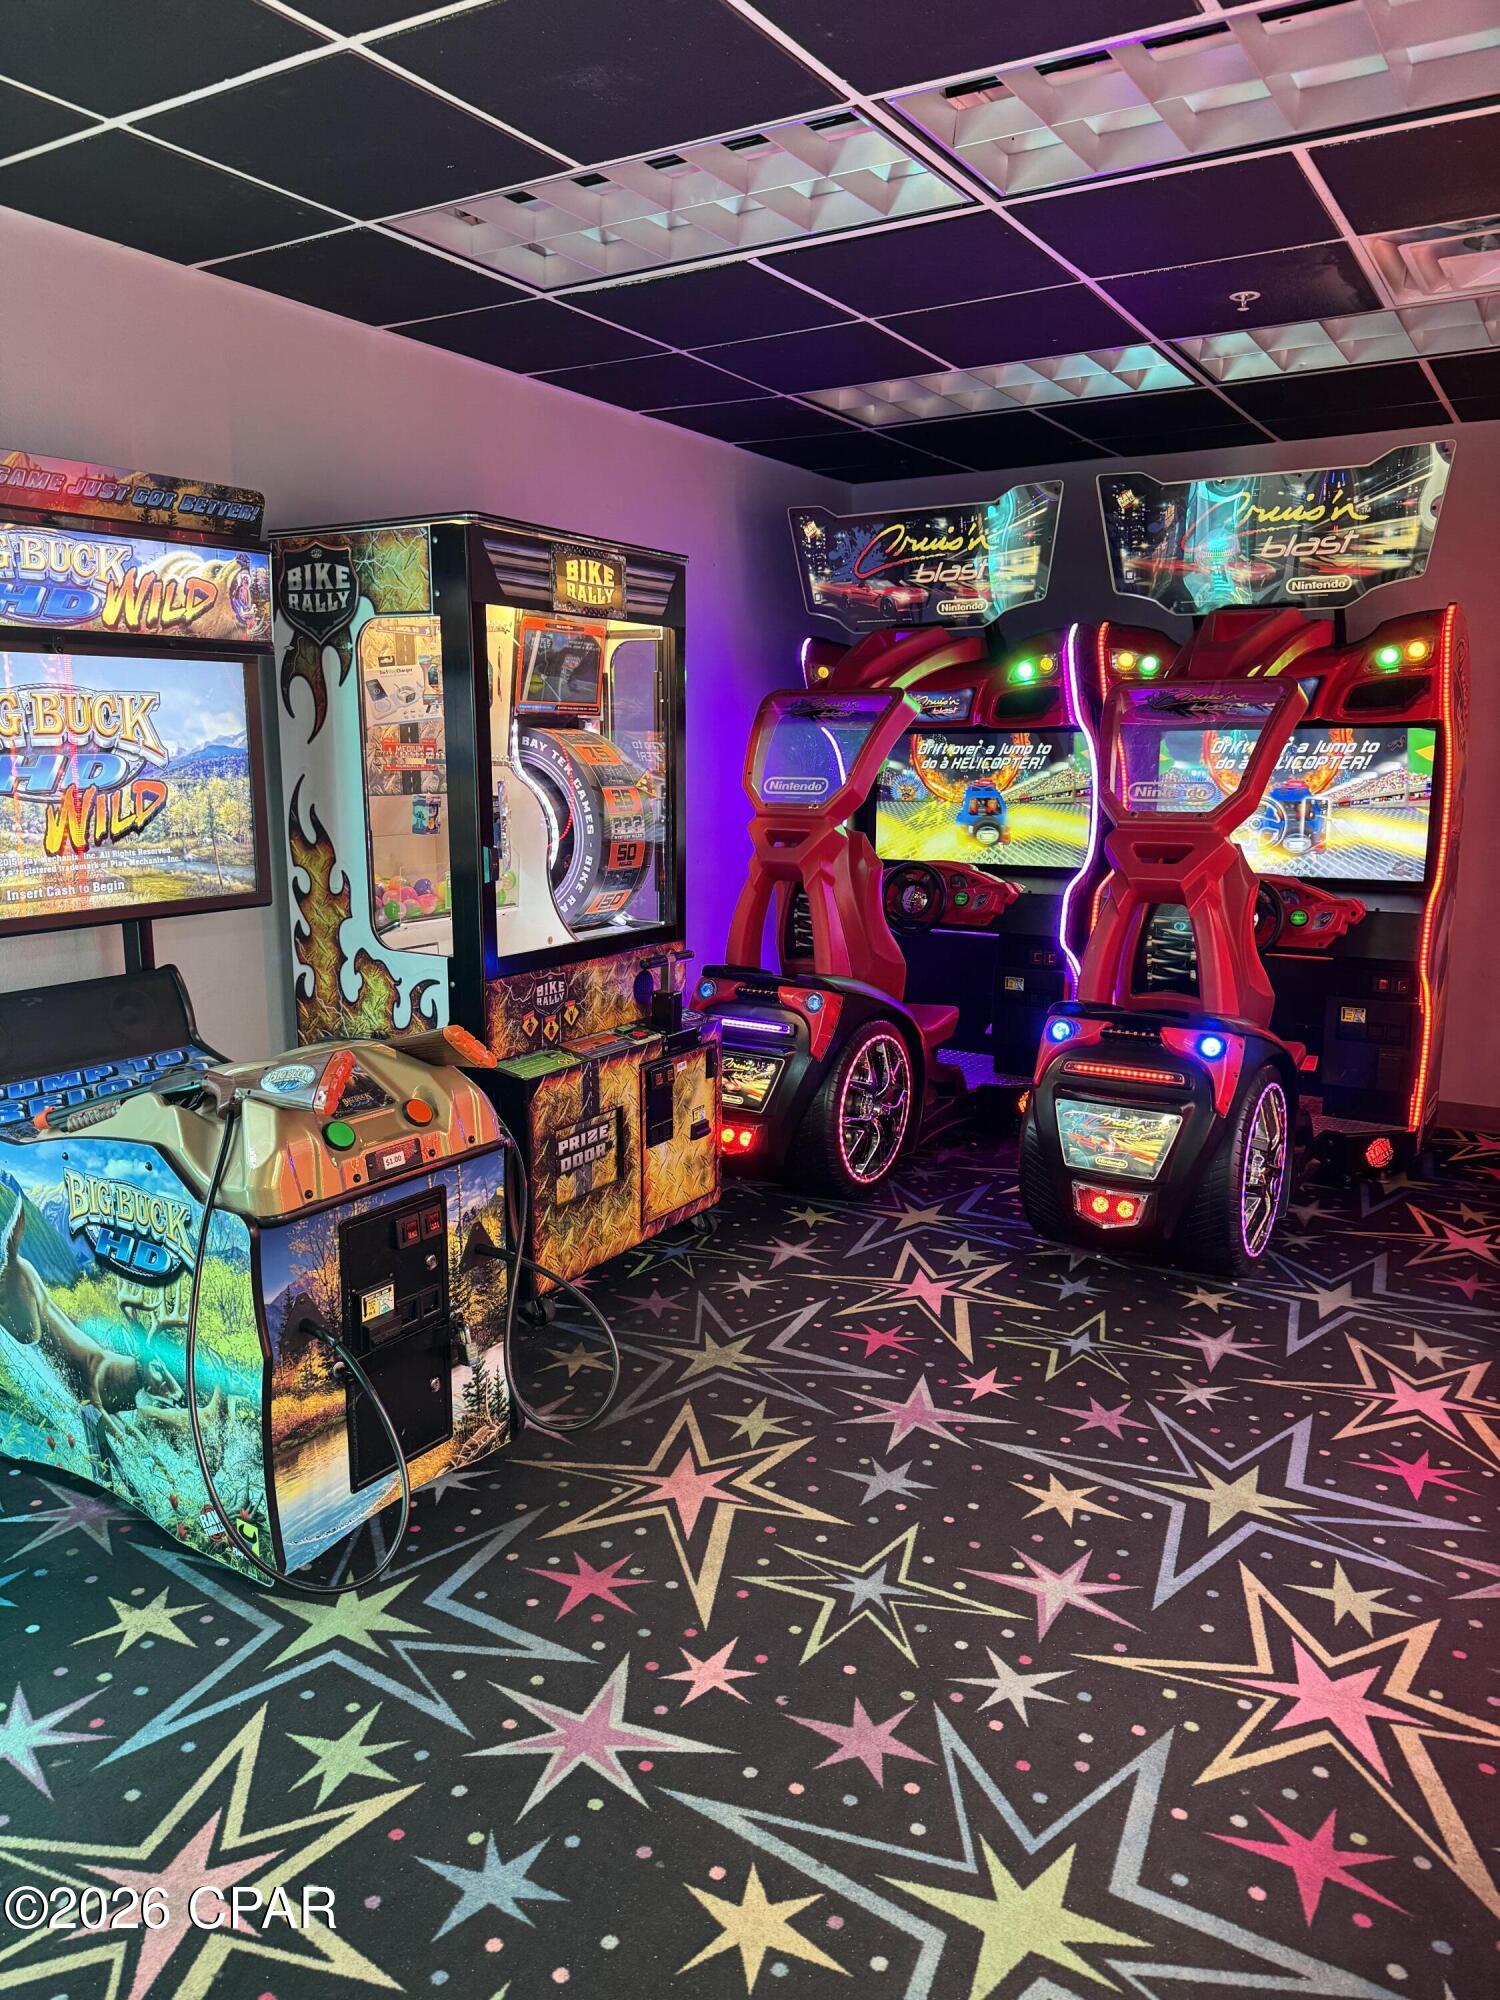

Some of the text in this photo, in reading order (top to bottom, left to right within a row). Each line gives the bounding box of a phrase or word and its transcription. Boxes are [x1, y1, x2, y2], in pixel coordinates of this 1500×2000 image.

[0, 466, 260, 522] GAME JUST GOT BETTER!
[1180, 488, 1370, 552] Cruis'n
[853, 523, 996, 580] Cruis'n
[1261, 529, 1359, 559] blast
[19, 535, 133, 586] BUCK
[565, 559, 615, 588] BIKE
[912, 558, 990, 584] blast
[287, 562, 351, 591] BIKE
[1290, 579, 1348, 591] Nintendo
[0, 566, 218, 632] HD WILD
[287, 590, 351, 613] RALLY
[566, 581, 615, 605] RALLY
[940, 602, 985, 613] Nintendo
[29, 691, 168, 761] BUCK
[521, 735, 548, 753] BAY
[918, 743, 950, 755] Drift
[951, 744, 981, 755] over
[985, 745, 996, 755] a
[1036, 743, 1052, 755] to
[1296, 743, 1307, 754] a
[1360, 740, 1381, 754] to
[0, 753, 130, 791] HD
[921, 758, 937, 770] do
[951, 756, 1047, 770] HELICOPTER!
[1216, 757, 1236, 769] do
[1274, 755, 1373, 770] LICOPTER!
[769, 781, 824, 791] Nintendo
[44, 779, 168, 856] WILD
[573, 777, 595, 837] GAMES
[100, 850, 110, 858] All
[112, 849, 136, 858] Rights
[617, 844, 637, 861] 50
[574, 855, 594, 895] BIKE
[6, 880, 126, 901] Insert Cash to Begin
[536, 980, 565, 997] BIKE
[536, 991, 565, 1006] RALLY
[0, 1050, 185, 1102] UMP TO
[557, 1123, 609, 1157] PRIZE
[385, 1154, 402, 1166] $1.00
[560, 1142, 607, 1173] DOOR
[65, 1172, 195, 1260] BIG BUCK
[95, 1226, 173, 1274] HD
